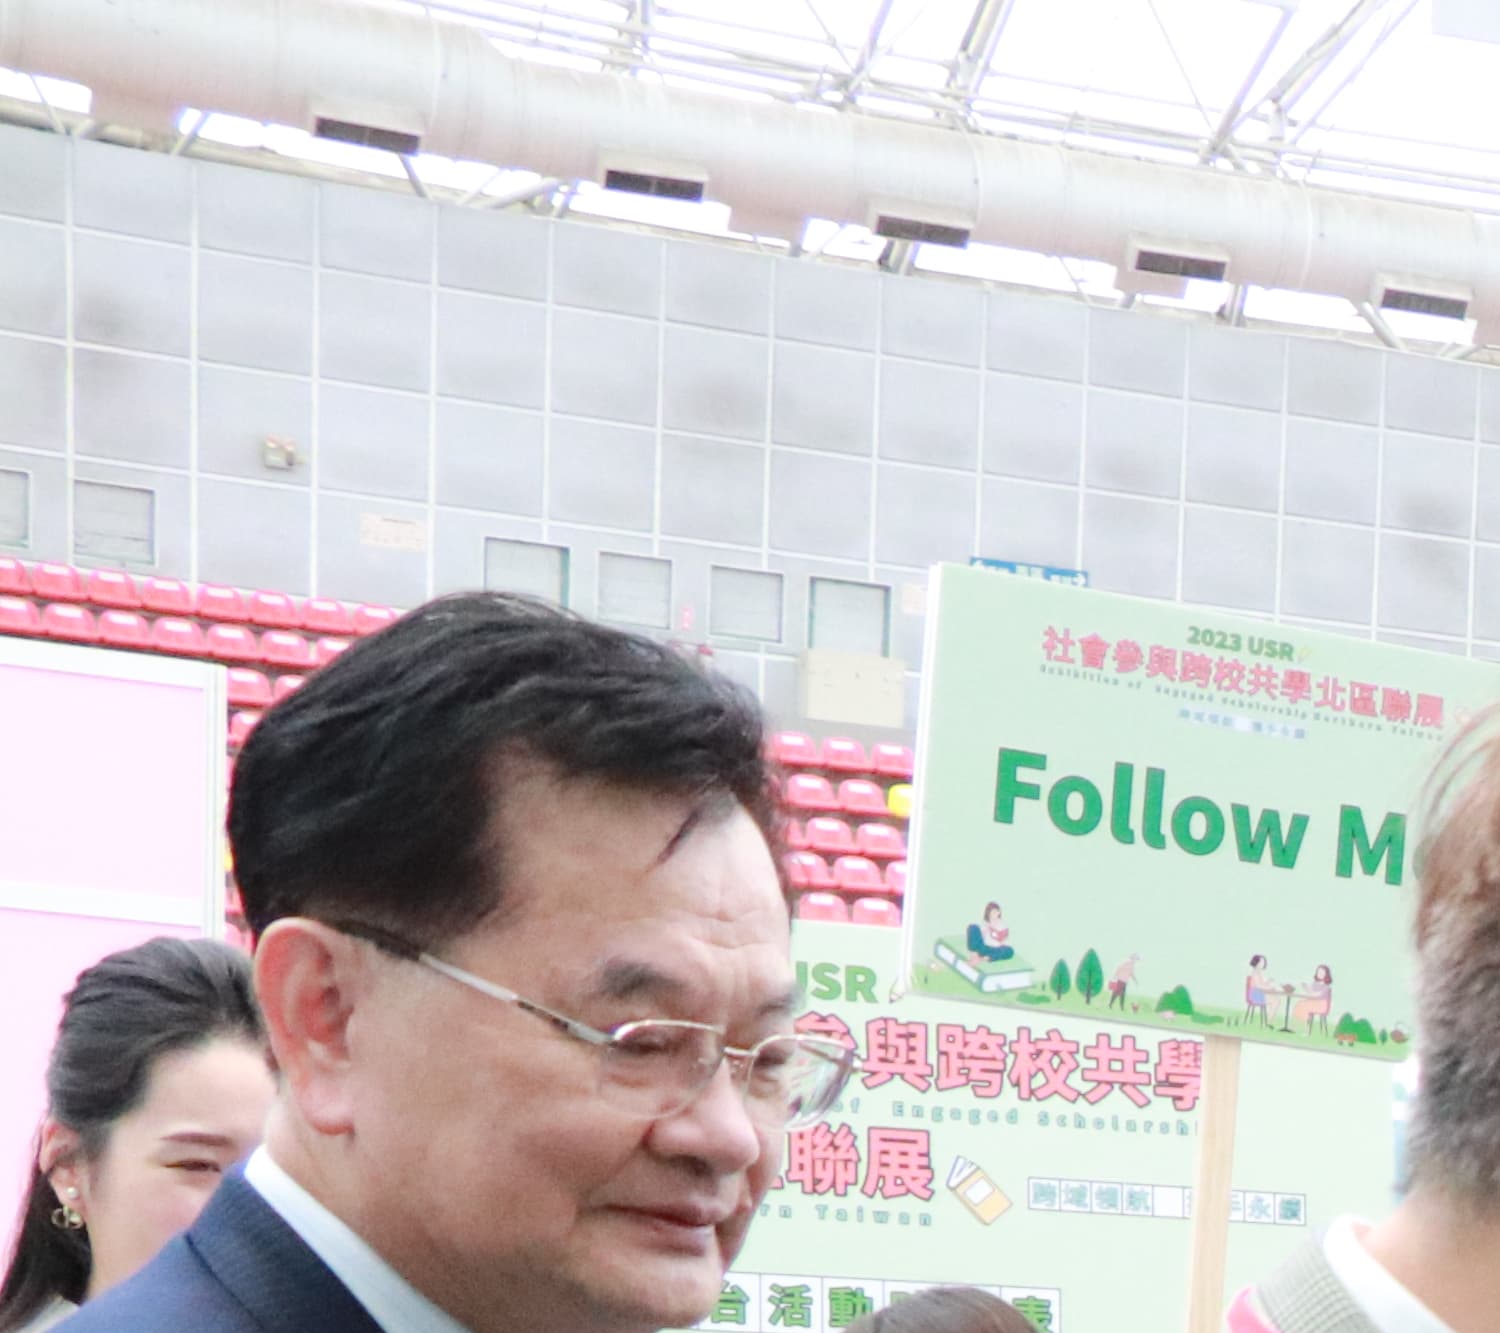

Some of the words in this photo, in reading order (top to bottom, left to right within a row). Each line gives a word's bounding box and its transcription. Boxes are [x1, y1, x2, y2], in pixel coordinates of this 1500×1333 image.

[1187, 625, 1242, 653] 2023
[1248, 637, 1295, 661] USR
[994, 747, 1308, 868] Follow
[892, 1101, 1020, 1126] Engaged
[816, 1204, 932, 1226] Taiwan
